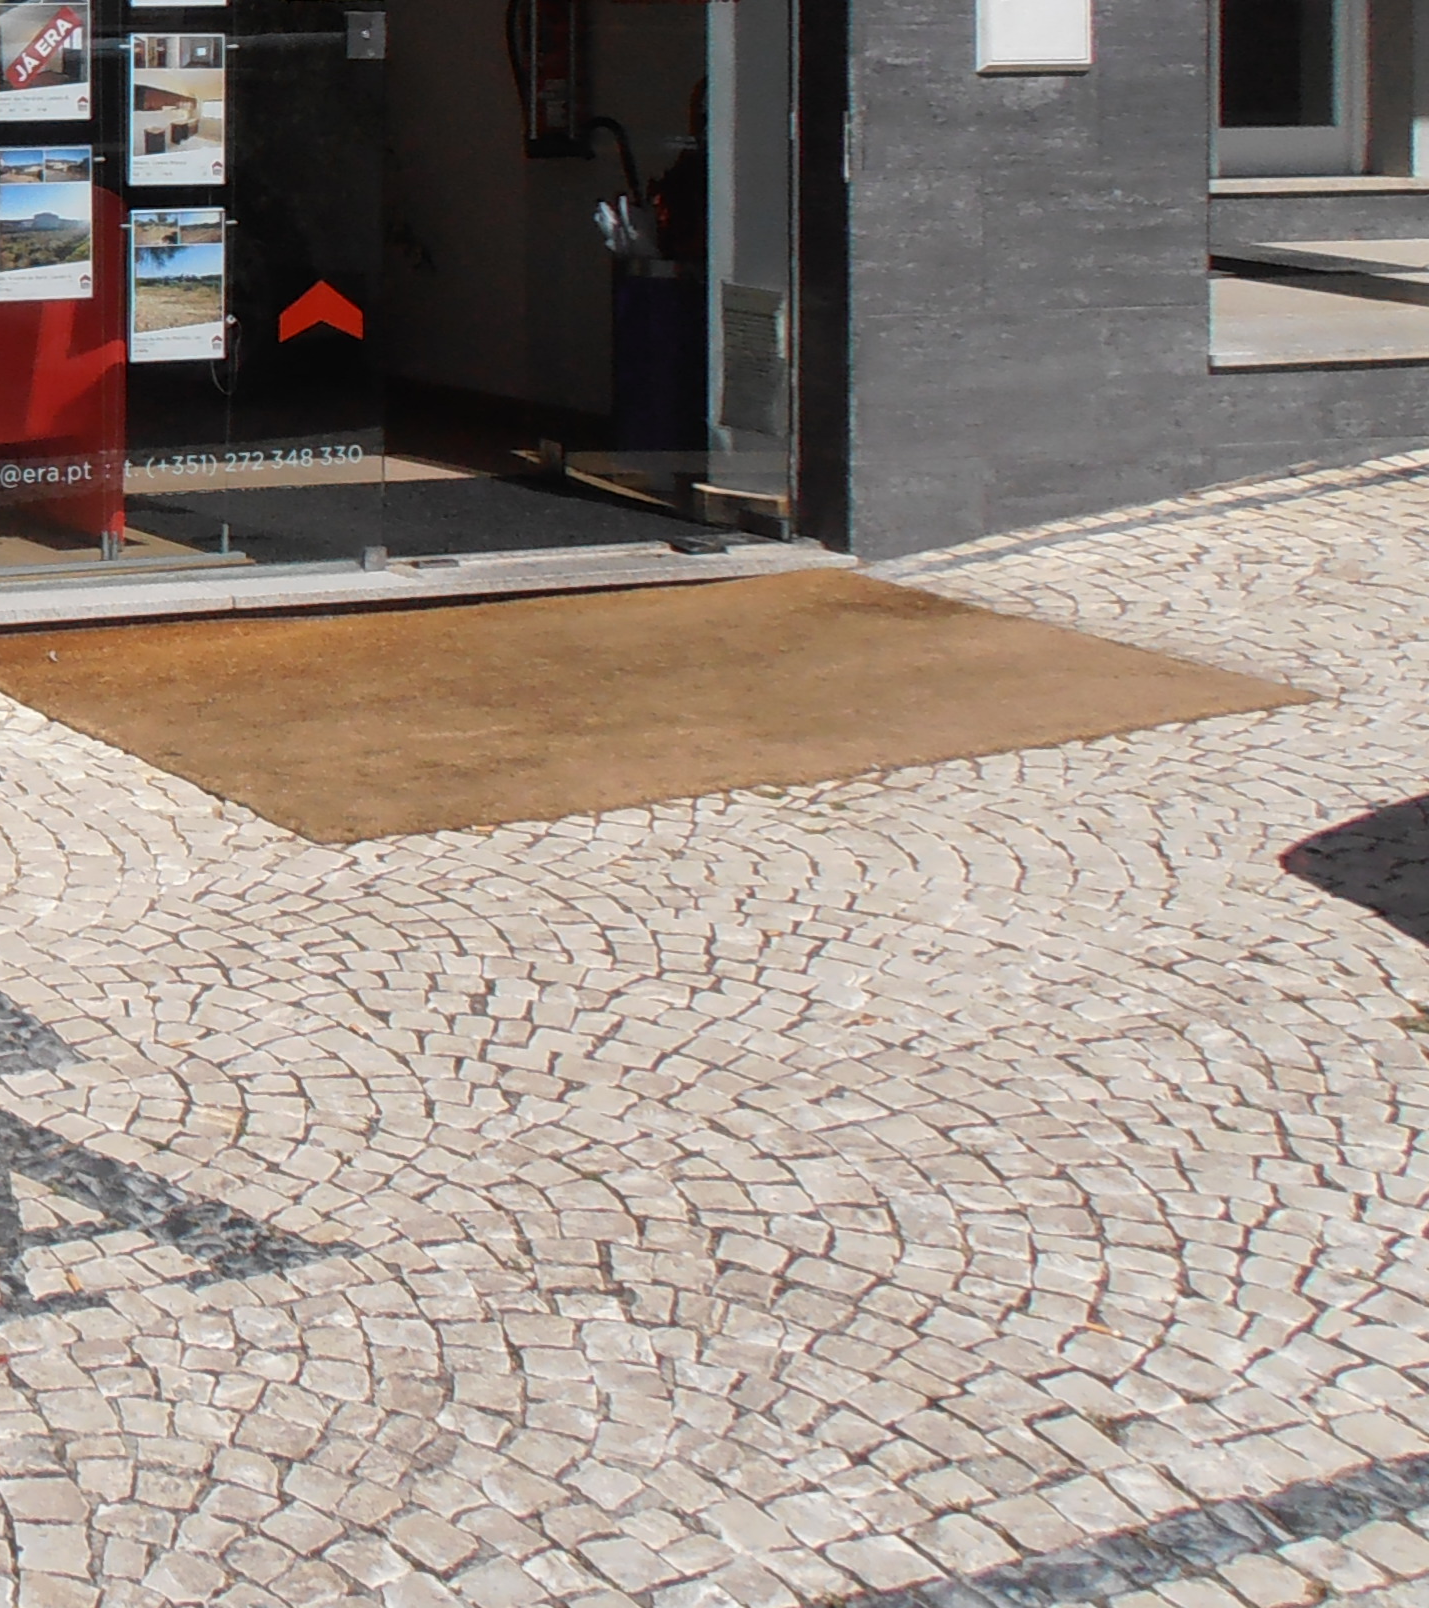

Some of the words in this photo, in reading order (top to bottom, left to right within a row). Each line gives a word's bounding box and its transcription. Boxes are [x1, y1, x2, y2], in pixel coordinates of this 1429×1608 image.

[15, 52, 40, 82] JÁ
[34, 19, 73, 58] ERA
[146, 452, 217, 480] (+351)
[224, 450, 264, 473] 272
[271, 447, 313, 470] 348
[320, 444, 363, 467] 330
